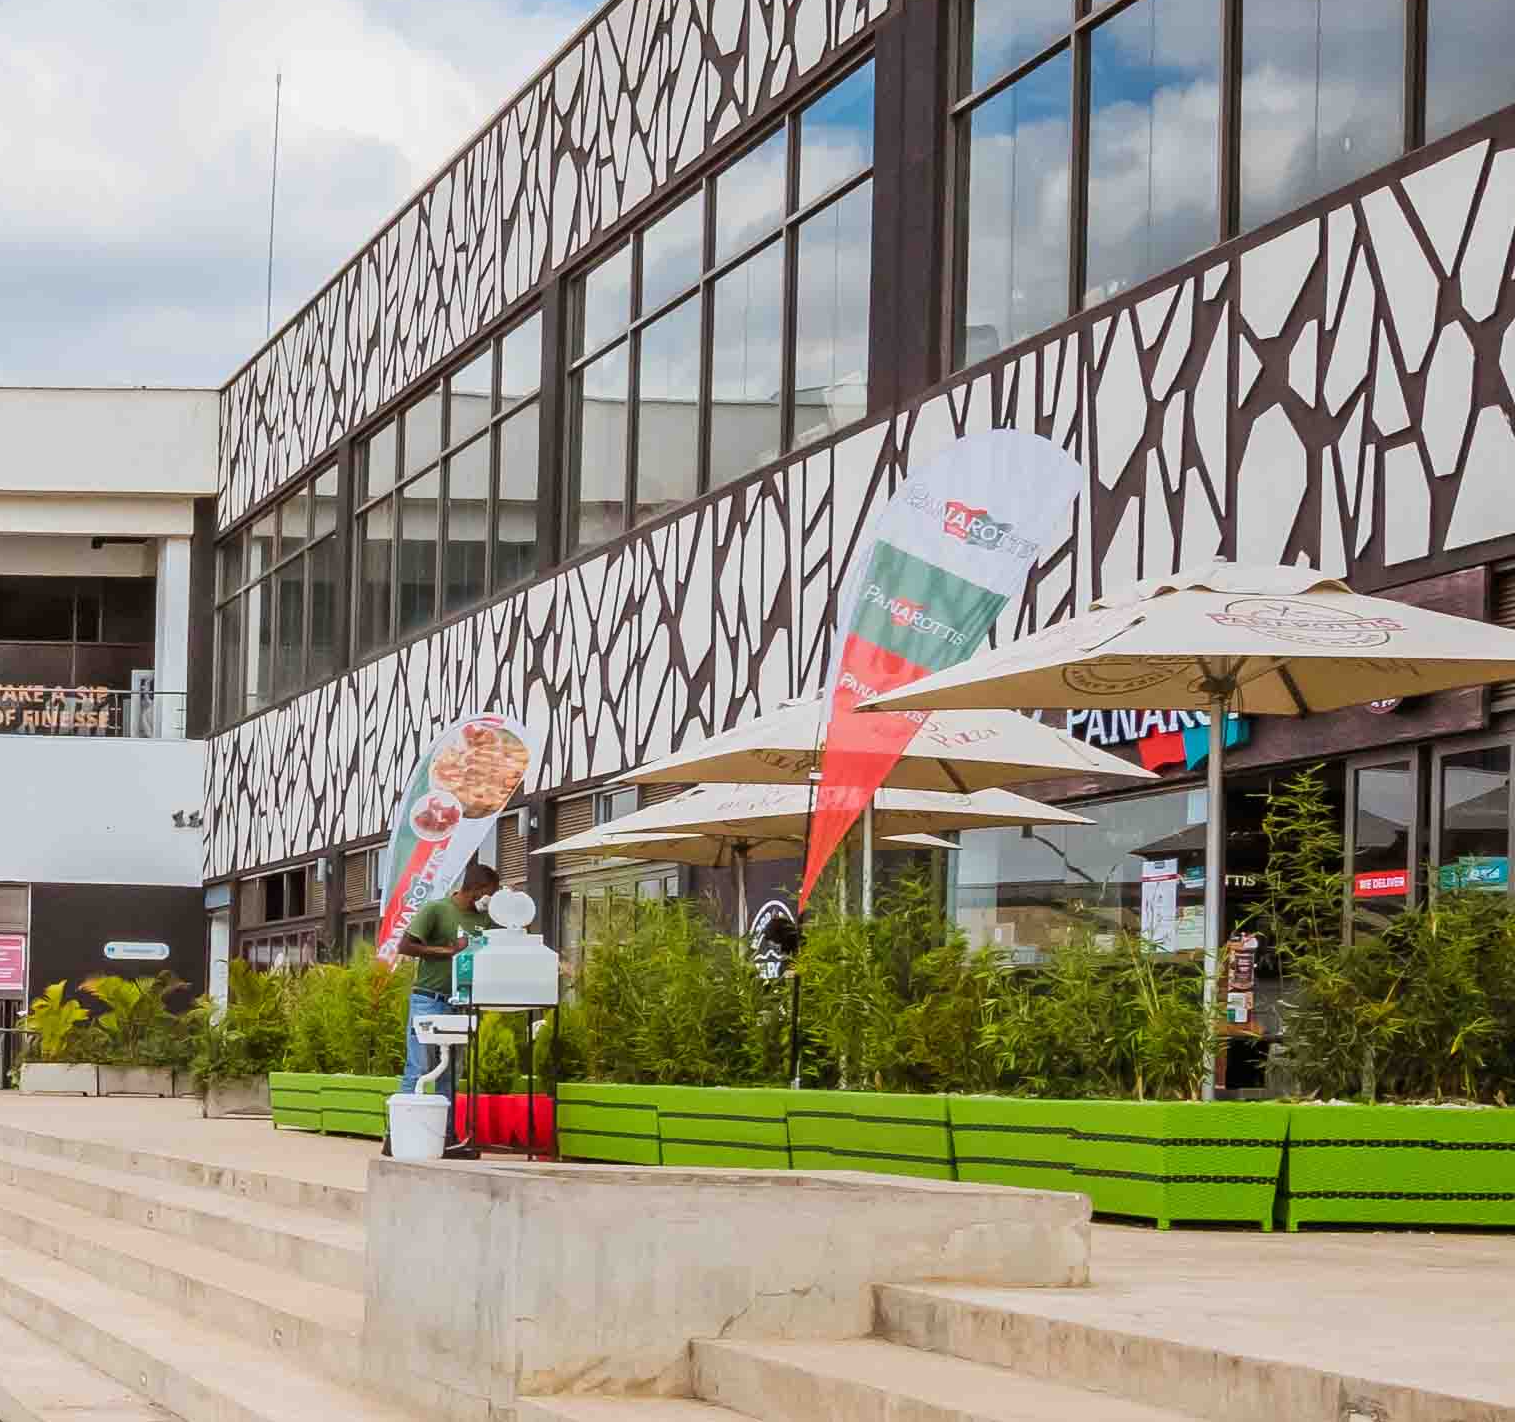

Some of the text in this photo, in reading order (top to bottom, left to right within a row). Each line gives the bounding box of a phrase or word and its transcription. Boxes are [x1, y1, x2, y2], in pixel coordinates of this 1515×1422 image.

[866, 583, 965, 648] PANAROTTIS
[22, 709, 109, 729] FINESSE
[1372, 876, 1405, 889] DELIVER
